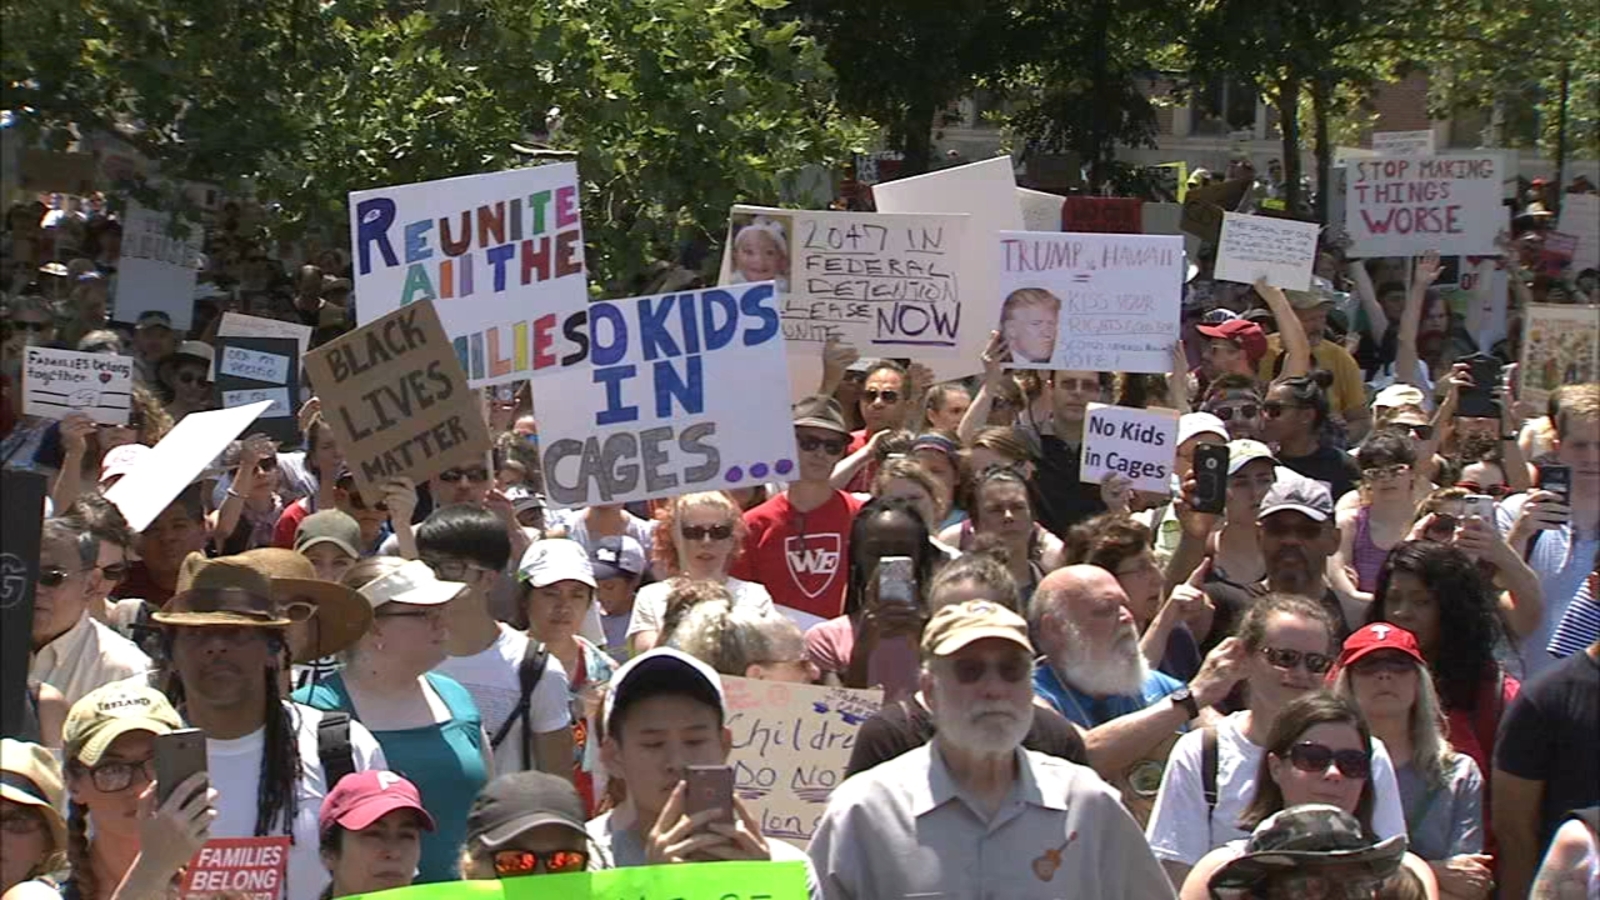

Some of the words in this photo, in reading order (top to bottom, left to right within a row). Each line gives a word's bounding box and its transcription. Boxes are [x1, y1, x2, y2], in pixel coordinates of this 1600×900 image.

[1357, 159, 1408, 182] STOP
[1419, 159, 1494, 180] MAKING
[1354, 182, 1450, 204] THINGS
[356, 185, 578, 276] REUNITE
[1360, 204, 1464, 234] WORSE
[907, 226, 943, 250] IN
[486, 229, 582, 293] THE
[805, 255, 950, 279] FEDERAL
[1001, 239, 1083, 272] TRUMP
[1101, 244, 1173, 269] HAWAII
[806, 274, 959, 303] DETENTION
[781, 300, 873, 320] LEASE
[876, 302, 962, 339] NOW
[589, 302, 628, 366] O
[636, 284, 780, 362] KIDS
[782, 319, 846, 341] UNITE
[325, 309, 427, 383] BLACK
[453, 310, 588, 380] ILIES
[339, 360, 454, 442] LIVES
[592, 354, 704, 425] IN
[1089, 415, 1115, 437] No
[1120, 421, 1166, 446] Kids
[361, 415, 468, 483] MATTER
[1085, 446, 1101, 467] in
[1105, 451, 1166, 479] Cages
[787, 547, 840, 575] WE
[97, 697, 151, 711] IRELAND
[727, 713, 855, 757] Childre
[376, 770, 401, 791] P
[733, 760, 776, 787] DO
[791, 766, 849, 789] NO
[761, 808, 822, 836] lon
[197, 846, 283, 867] FAMILIES
[189, 868, 278, 891] BELONG
